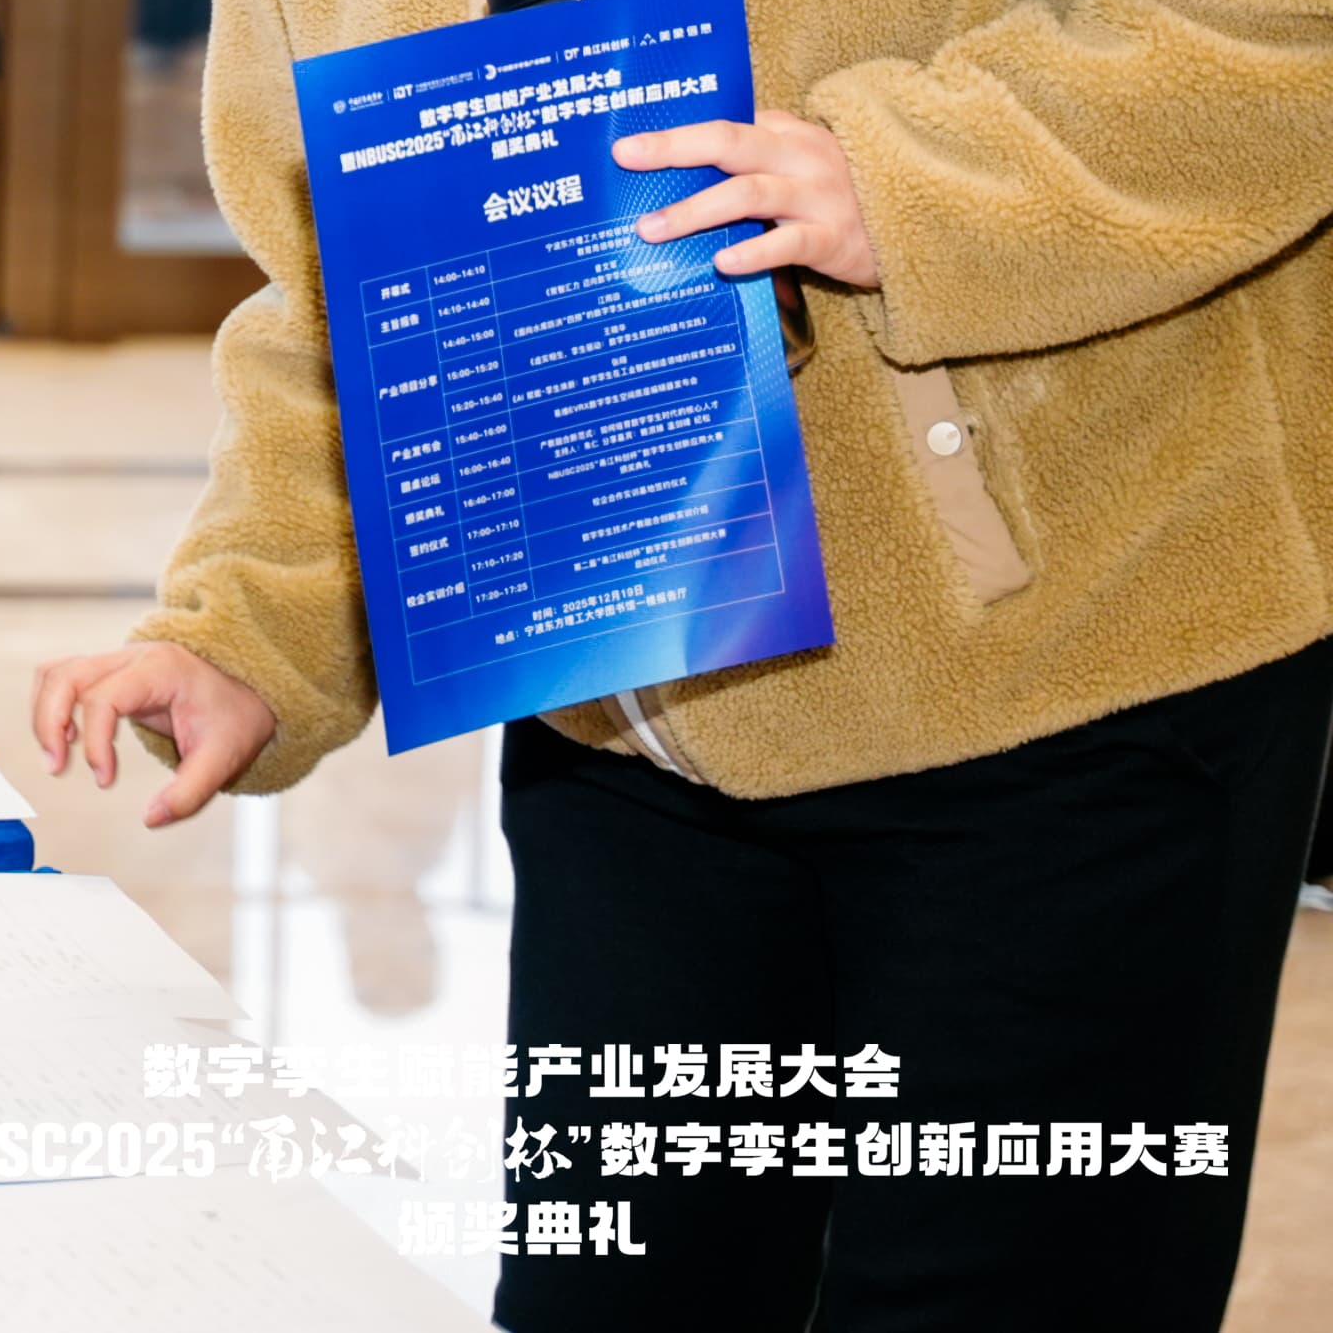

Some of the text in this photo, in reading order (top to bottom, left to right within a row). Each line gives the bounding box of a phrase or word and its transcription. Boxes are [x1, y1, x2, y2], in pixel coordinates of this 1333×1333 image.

[483, 175, 583, 222] 会议议程
[434, 265, 485, 285] 14:00-14:10
[468, 519, 519, 539] 17:00-17:10
